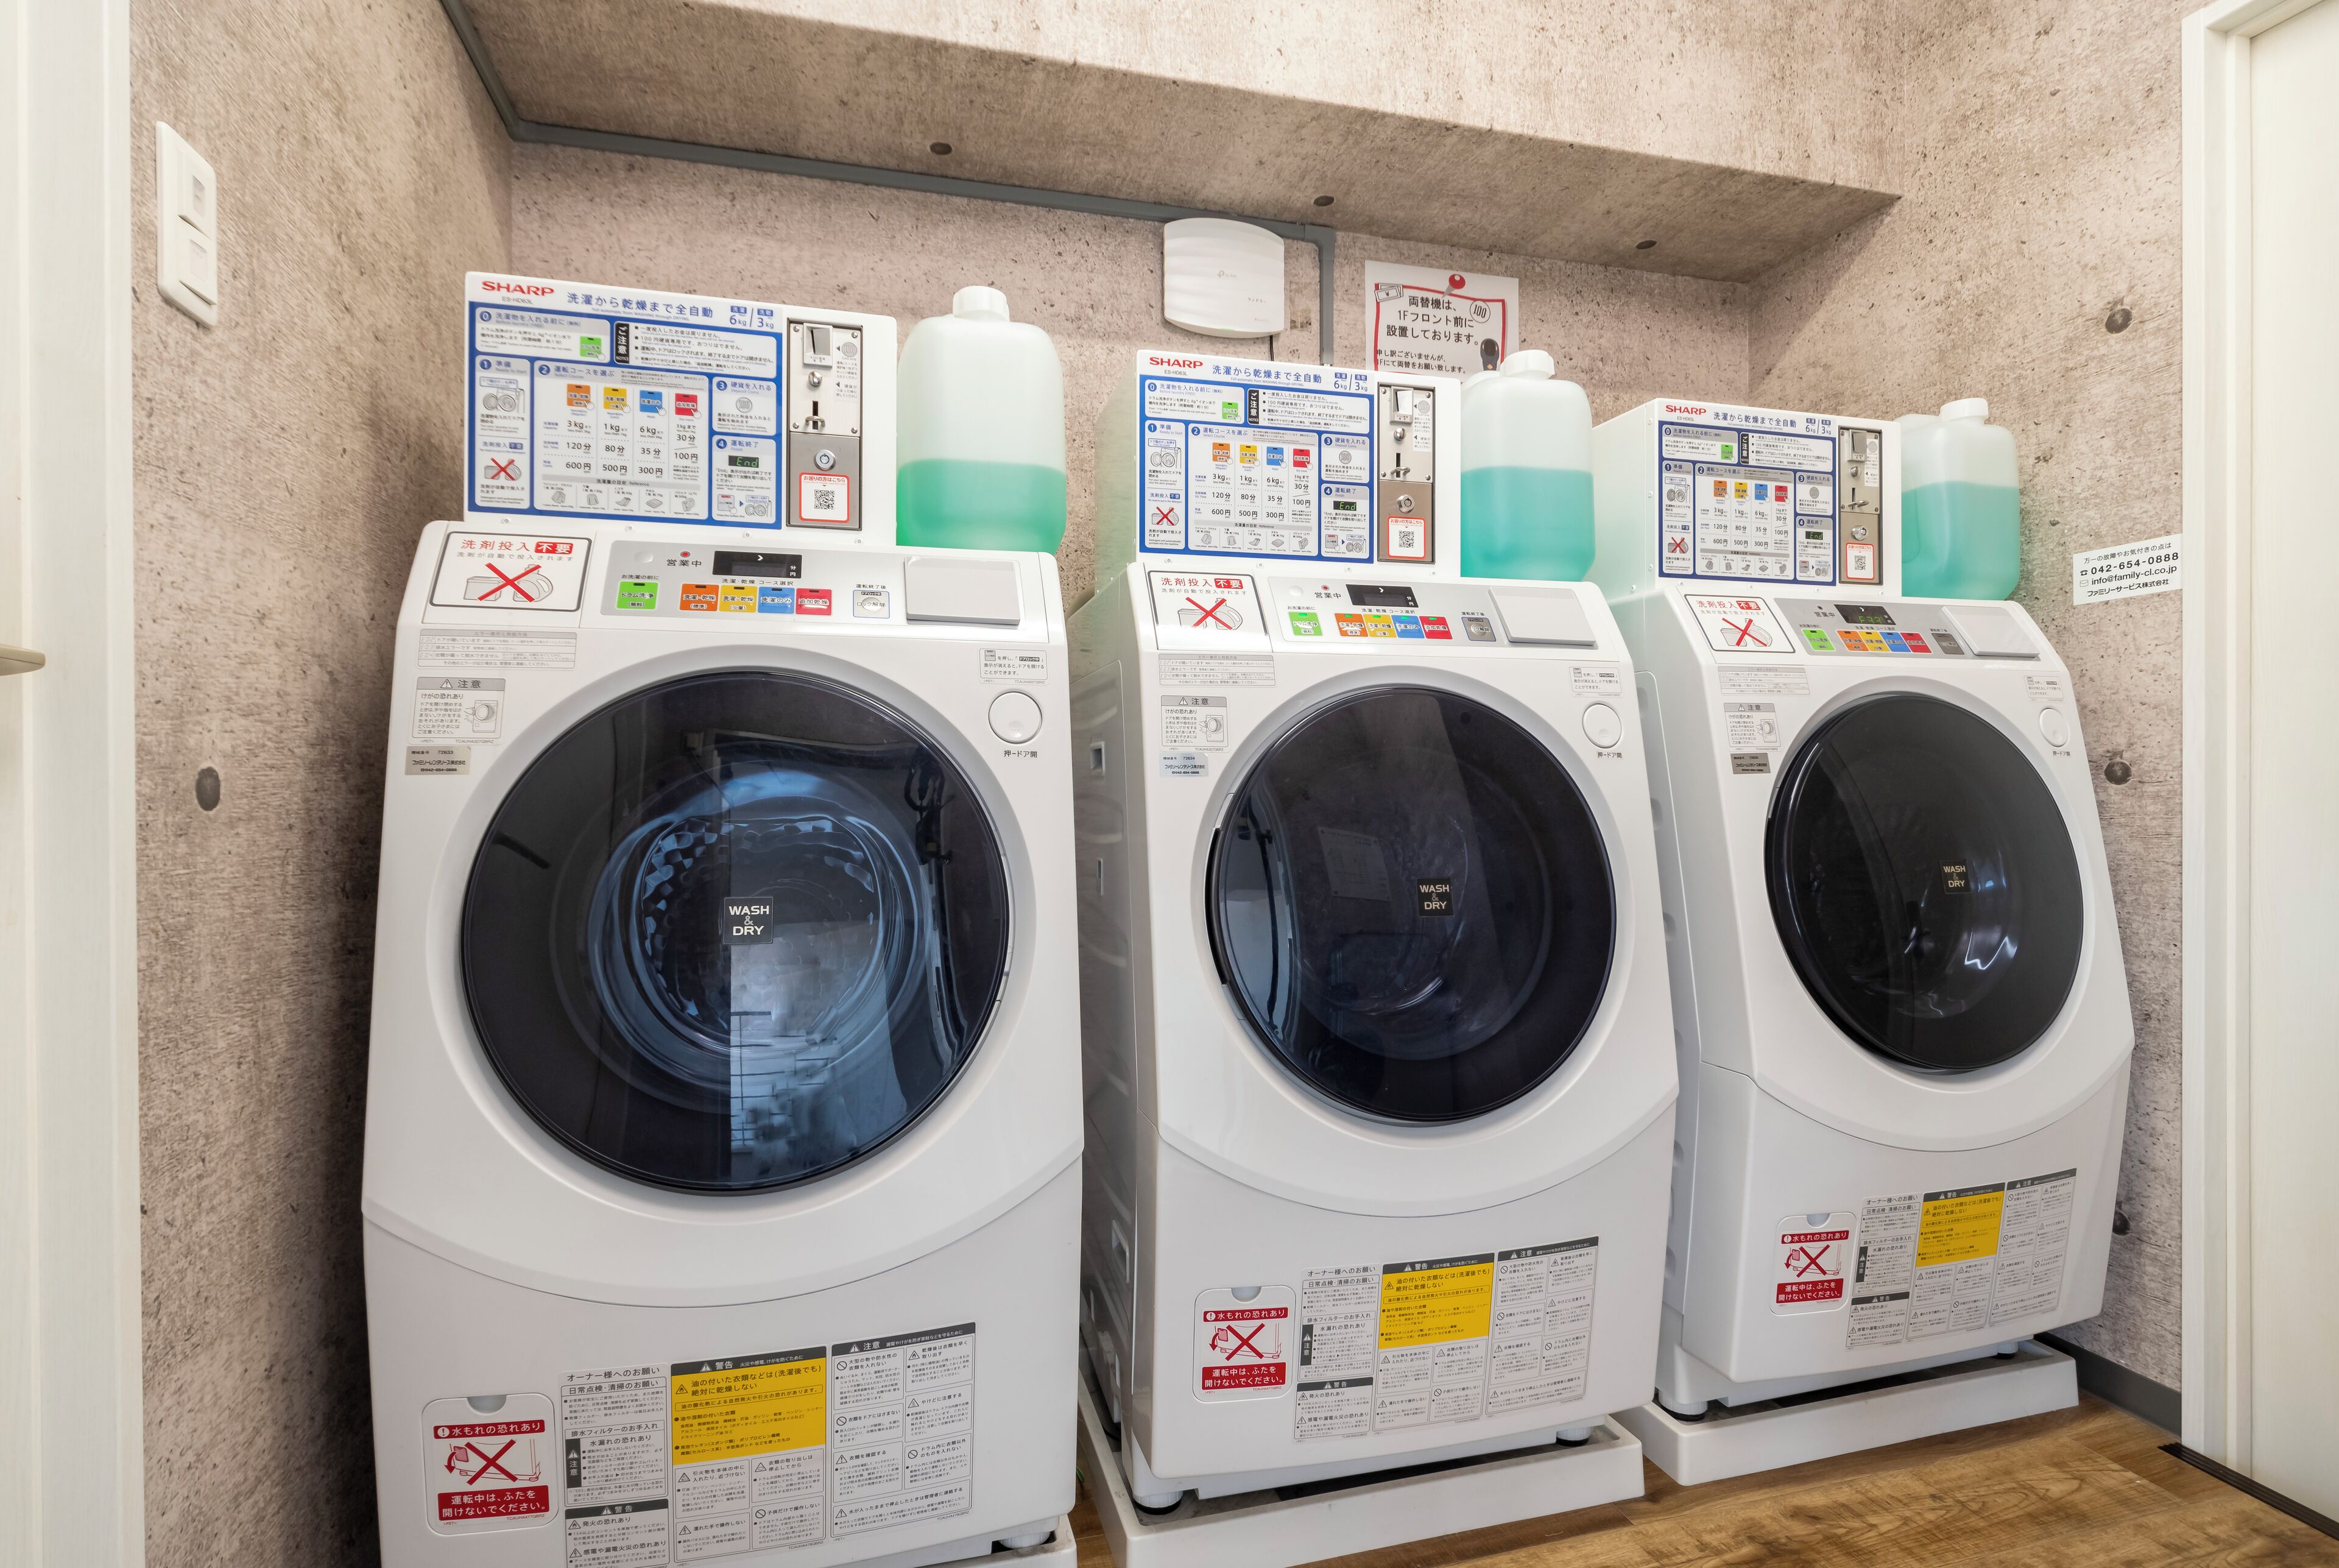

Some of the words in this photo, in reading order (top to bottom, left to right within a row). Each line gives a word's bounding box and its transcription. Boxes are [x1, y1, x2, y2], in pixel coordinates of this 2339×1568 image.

[482, 281, 555, 296] SHARP
[567, 292, 713, 318] 洗濯から乾燥まで全自動
[1408, 295, 1456, 311] 両替機は、
[1398, 310, 1474, 328] 1Fフロント前に
[618, 326, 627, 354] ご注意
[1386, 325, 1478, 345] 設置しております。
[1377, 349, 1446, 362] 申し訳ございませんが、
[1149, 357, 1203, 369] SHARP
[1212, 365, 1322, 383] 洗濯から乾燥まで全自動
[731, 381, 771, 391] 硬貨を入れる
[1160, 383, 1211, 392] 洗濯物を入れる前に
[1665, 405, 1706, 415] SHARP
[1713, 411, 1796, 428] 洗濯から乾燥まで全自動
[1203, 427, 1247, 436] 運転コースを選ぶ
[736, 457, 758, 467] End
[461, 539, 531, 552] 洗剤投入
[537, 542, 573, 554] 不要
[456, 551, 574, 562] 洗剤が自動で投入されます
[2084, 542, 2171, 564] 万一の故障やお気付きの点は
[666, 559, 701, 567] 営業中
[2091, 553, 2179, 574] 042-654-0888
[2092, 565, 2177, 585] info@family-cl.co.jp
[1161, 577, 1213, 587] 洗剤投入
[1216, 579, 1241, 588] 不要
[2087, 579, 2169, 597] ファミリーサービス株式会社
[1696, 600, 1738, 609] 洗剤投入
[1739, 601, 1760, 610] 不要
[458, 679, 481, 688] 注意
[729, 905, 769, 915] WASH
[744, 916, 753, 925] &
[733, 926, 764, 936] DRY
[1866, 1195, 1918, 1205] オーナー様へのお願い
[1793, 1232, 1846, 1242] 水もれの恐れあり
[1307, 1266, 1375, 1277] オーナー様へのお願い
[1395, 1282, 1444, 1292] 絶対に乾燥しない
[1785, 1282, 1835, 1291] 運転中は、ふたを
[1779, 1290, 1840, 1301] 開けないでください。
[1218, 1310, 1285, 1320] 水もれの恐れあり
[1307, 1313, 1371, 1323] 排水フィルターのお手入れ
[1321, 1323, 1365, 1332] 水漏れの恐れあり
[864, 1341, 880, 1351] 注意
[922, 1341, 967, 1352] 乾燥後は衣類を早く
[848, 1353, 897, 1364] 大型の物や防水性の
[715, 1361, 733, 1370] 警告
[848, 1361, 886, 1371] 衣類を入れない
[566, 1367, 660, 1382] オーナー様へのお願い
[691, 1365, 822, 1387] 油の付いた衣類などは(洗濯後でも)
[1212, 1366, 1276, 1377] 運転中は、ふたを
[570, 1380, 658, 1394] 日常点検・清掃のお願い
[1204, 1376, 1282, 1387] 開けないでください。
[691, 1383, 757, 1396] 絶対に乾燥しない
[922, 1393, 962, 1404] やけどに注意する
[848, 1410, 900, 1422] 衣類をドアにはさまない
[451, 1422, 540, 1436] 水もれの恐れあり
[571, 1423, 658, 1437] 排水フィルターのお手入れ
[590, 1435, 651, 1447] 水漏れの恐れあり
[921, 1439, 966, 1451] ドラム内に衣類以外
[849, 1450, 886, 1460] 衣類を確認する
[920, 1446, 961, 1457] のものを入れない
[769, 1455, 813, 1465] 衣類の取り出しは
[570, 1461, 578, 1476] 注意
[693, 1464, 745, 1475] 引火物を本体の中に
[769, 1463, 802, 1472] 停止してから
[693, 1471, 746, 1482] 入れたり、近づけない
[451, 1490, 536, 1505] 運転中は、ふたを
[442, 1502, 546, 1517] 開けないでください。
[767, 1503, 820, 1514] 子供だけで操作しない
[582, 1517, 631, 1527] 発火の恐れあり
[694, 1520, 746, 1531] 濡れた手で操作しない
[584, 1541, 666, 1555] 感電や漏電火災の恐れあり
